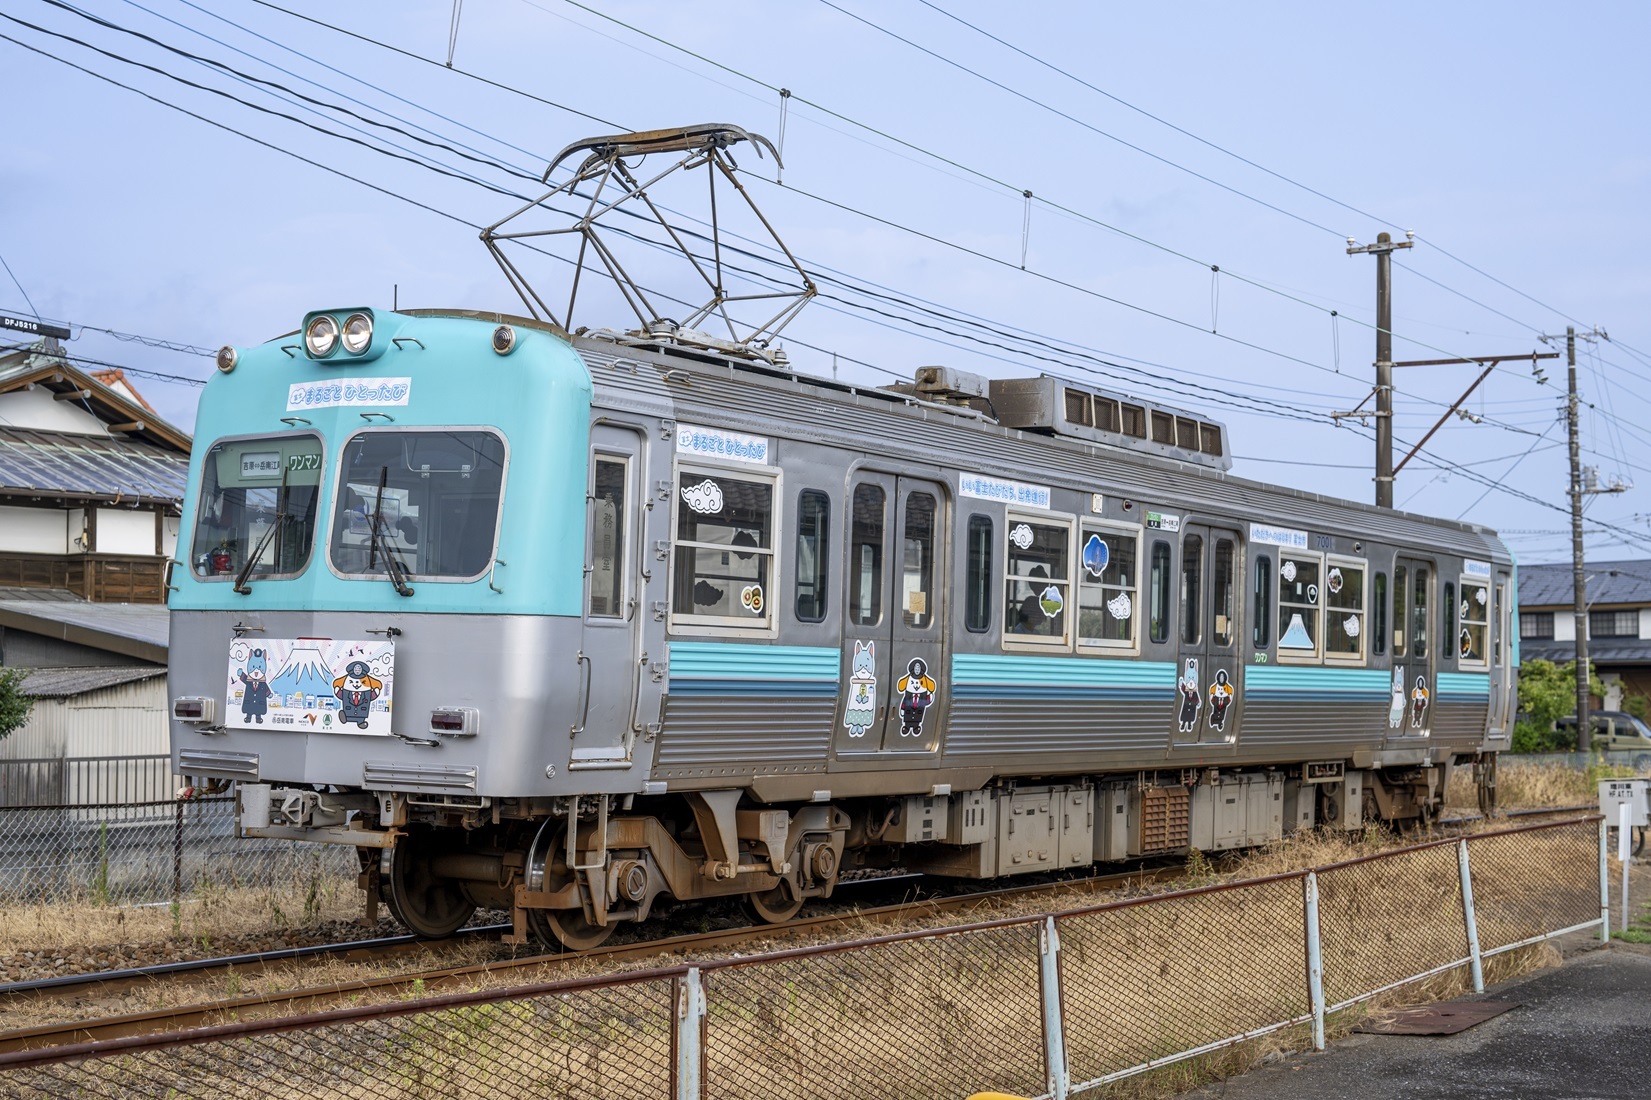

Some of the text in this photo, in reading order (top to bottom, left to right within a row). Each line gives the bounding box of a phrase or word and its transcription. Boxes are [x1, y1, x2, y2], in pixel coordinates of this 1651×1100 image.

[290, 454, 320, 471] ワンマン
[602, 492, 614, 571] 乗務員室
